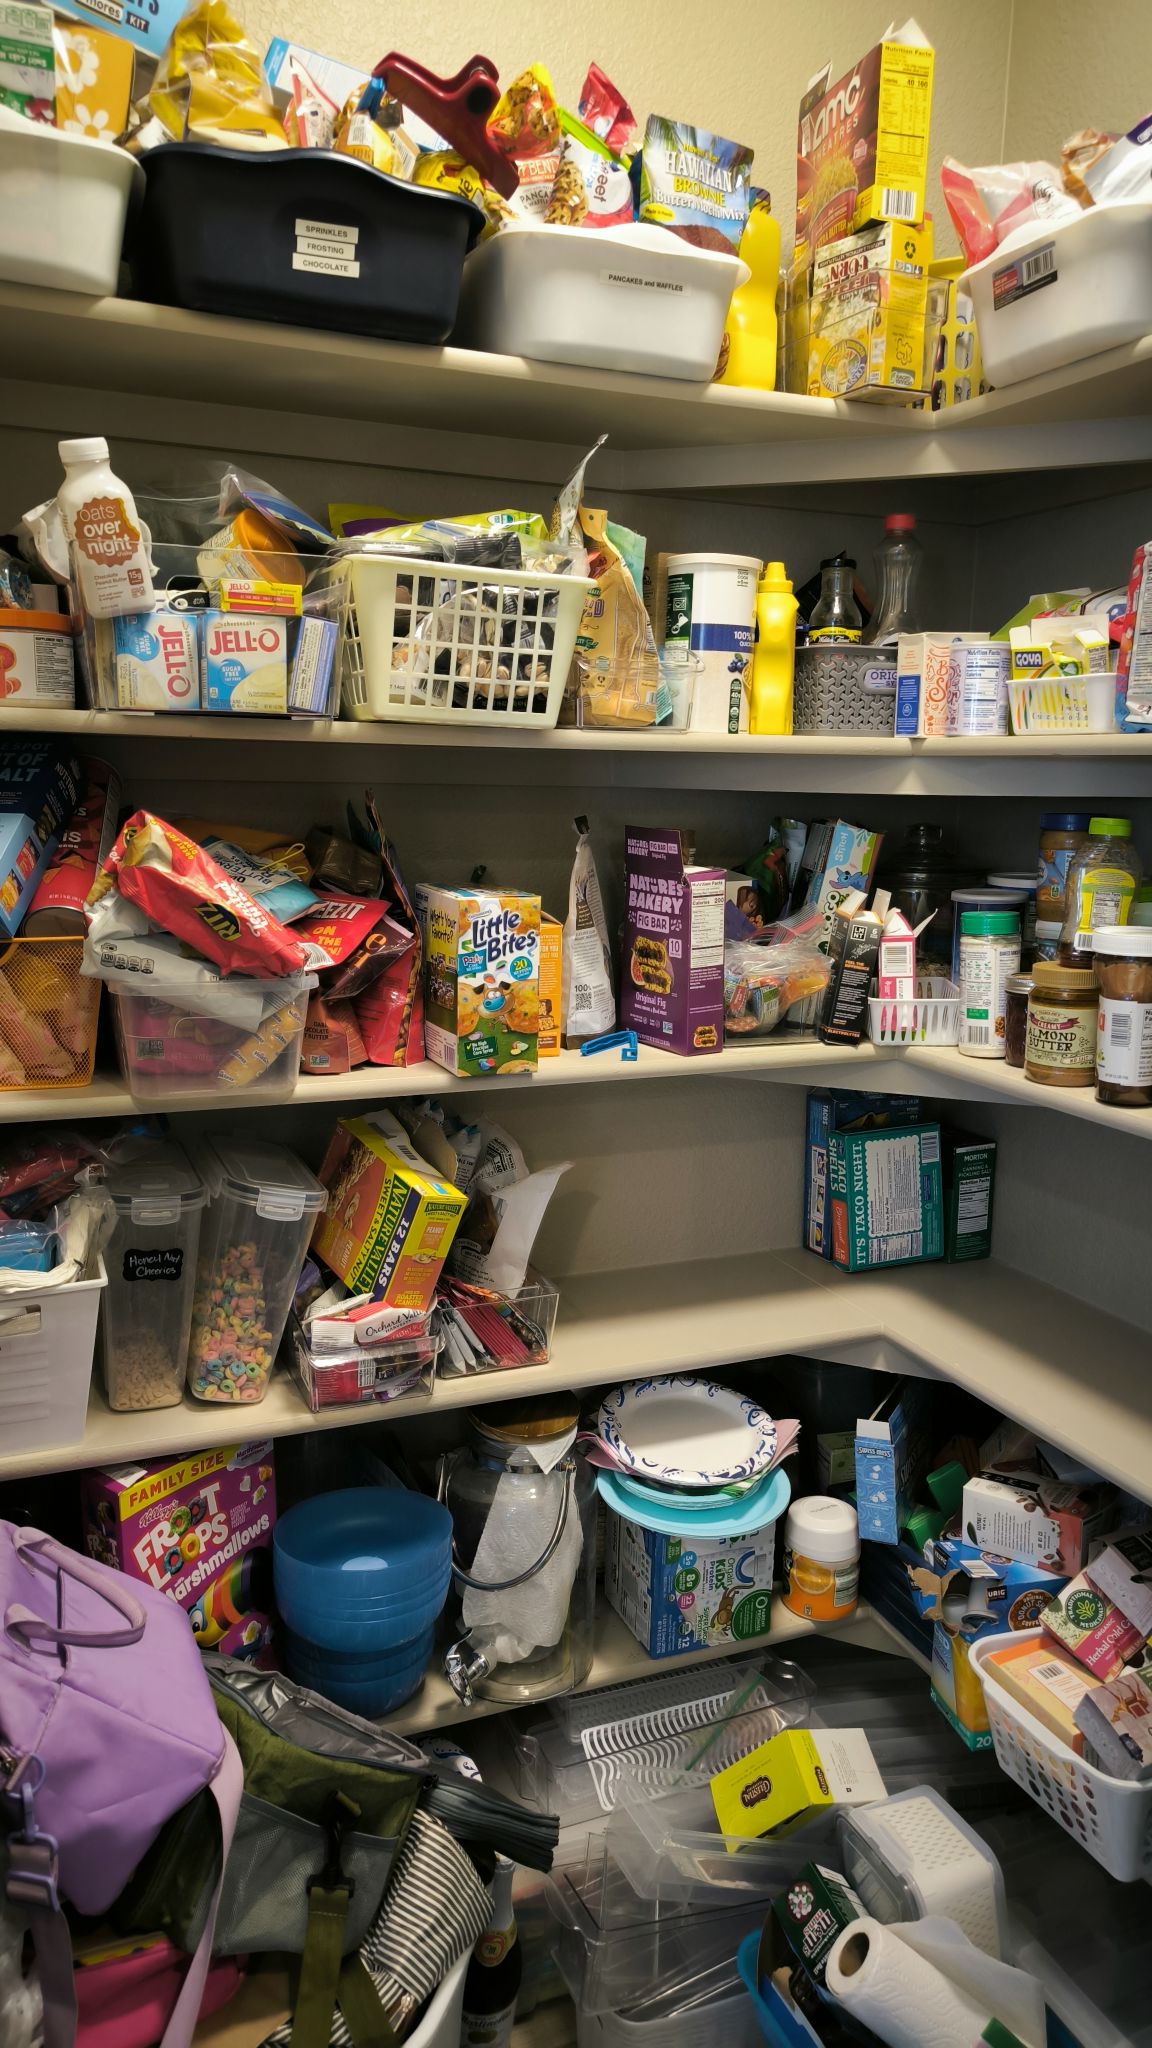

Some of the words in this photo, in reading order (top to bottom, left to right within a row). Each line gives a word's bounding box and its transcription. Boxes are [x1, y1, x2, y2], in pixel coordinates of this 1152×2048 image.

[129, 15, 146, 31] KIT
[665, 150, 733, 193] HAWAIIAN
[673, 176, 726, 208] BROWNIE
[656, 188, 694, 209] Butter
[721, 208, 746, 221] Mix
[305, 225, 349, 239] SPRINKLES
[306, 242, 345, 255] FROSTING
[302, 259, 349, 272] CHOCOLATE
[829, 254, 869, 283] CORN
[608, 274, 642, 285] PANCAKES
[644, 279, 655, 288] and
[656, 281, 684, 292] WAFFLES
[80, 504, 116, 522] oats
[83, 520, 122, 538] over
[87, 534, 132, 557] night
[208, 627, 281, 656] JELL-O
[157, 624, 192, 698] JELL-O
[221, 665, 242, 673] SUGAR
[1015, 651, 1043, 667] GOYA
[627, 846, 649, 857] BAKERY
[658, 842, 667, 851] BAR
[628, 890, 684, 915] BAKERY
[193, 902, 242, 943] RITZ
[312, 925, 337, 936] ON
[471, 909, 520, 949] Little
[638, 914, 649, 927] FIG
[651, 916, 667, 930] BAR
[318, 935, 343, 946] THE
[431, 924, 455, 945] Favorite?
[670, 940, 680, 950] 10
[487, 930, 536, 963] Bites
[513, 959, 529, 969] 20
[635, 991, 657, 1005] Original
[657, 997, 667, 1009] Fig
[1028, 1027, 1077, 1043] ALMOND
[1037, 1022, 1062, 1031] CREAMY
[1028, 1036, 1074, 1052] BUTTER
[828, 1137, 840, 1192] SHELLS
[851, 1140, 865, 1192] NIGHT.
[963, 1153, 988, 1162] MORTON
[837, 1159, 848, 1194] TACO
[377, 1177, 392, 1218] SWEET
[378, 1175, 409, 1245] NATURE
[855, 1195, 867, 1235] TACO
[396, 1217, 411, 1240] 12
[360, 1225, 377, 1258] SALTY
[855, 1237, 867, 1265] IT'S
[350, 1261, 362, 1282] NUT
[356, 1242, 386, 1294] VALLEY
[378, 1242, 401, 1288] BARS
[365, 1315, 402, 1338] Orchard
[129, 1471, 185, 1508] FAMILY
[190, 1450, 226, 1478] SIZE
[138, 1499, 179, 1529] Kellogg's
[133, 1481, 221, 1574] FROOT
[147, 1512, 229, 1591] LOOPS
[685, 1554, 693, 1566] 3g
[686, 1573, 696, 1587] 8g
[708, 1560, 716, 1591] Protein
[726, 1557, 736, 1587] Orgain
[988, 1589, 1006, 1598] URIG
[1066, 1591, 1093, 1619] TRADITIONAL
[1017, 1600, 1036, 1622] DONUT
[1080, 1602, 1105, 1629] MEDICINALS
[1094, 1617, 1117, 1640] ORGANIC
[682, 1636, 690, 1649] 12
[1085, 1639, 1110, 1667] Herbal
[1106, 1626, 1124, 1647] Cold
[975, 1735, 992, 1749] 20
[744, 1779, 771, 1804] CELESTIAL
